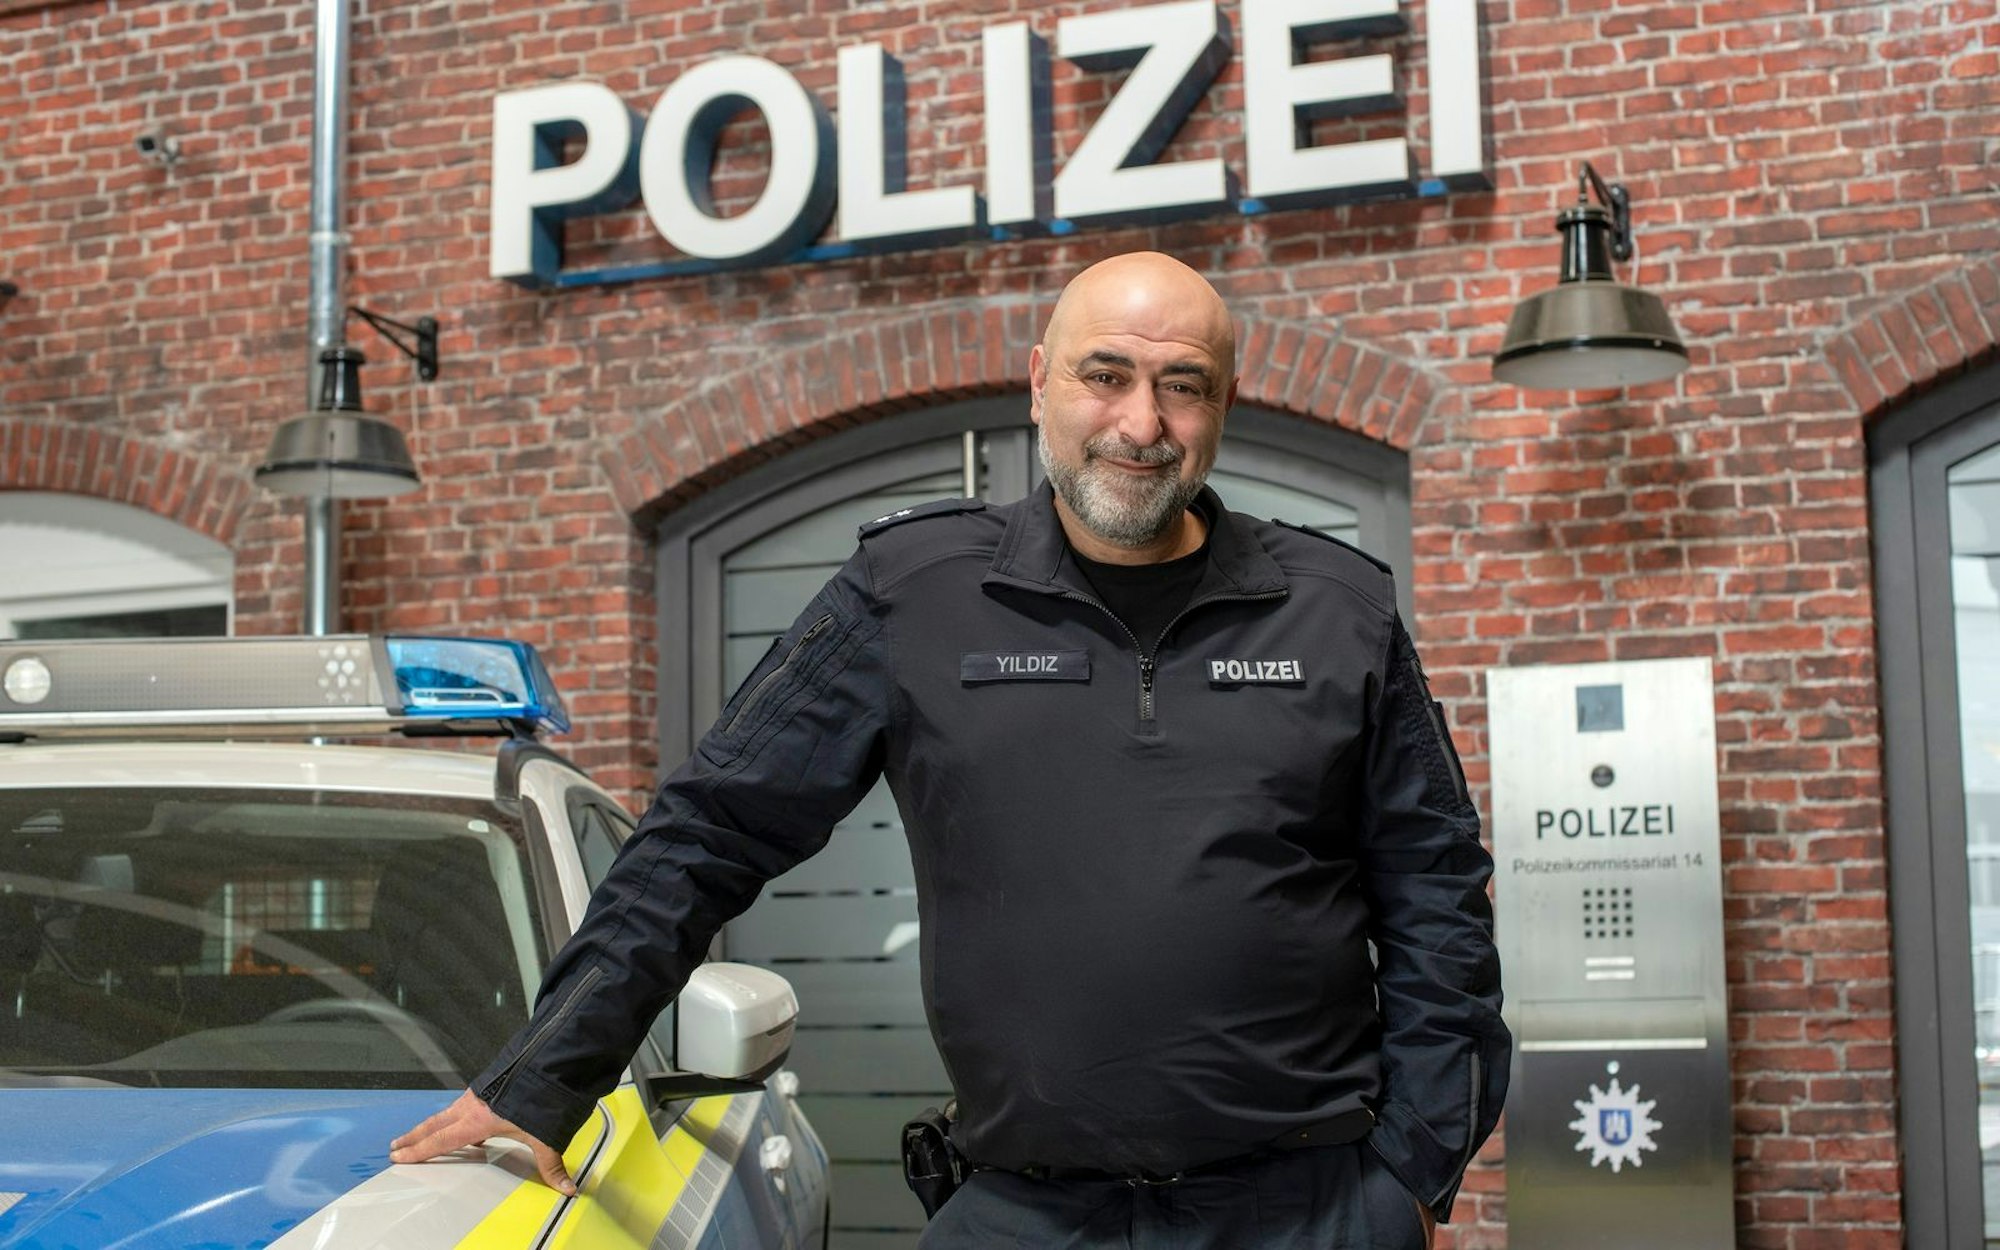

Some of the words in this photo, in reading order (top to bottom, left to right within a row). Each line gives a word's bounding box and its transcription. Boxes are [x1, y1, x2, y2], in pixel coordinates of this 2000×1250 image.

[489, 0, 1484, 278] POLIZEI
[996, 655, 1059, 673] YILDIZ
[1211, 660, 1301, 681] POLIZEI
[1536, 805, 1674, 839] POLIZEI
[1513, 855, 1677, 874] Polizeikommissariat
[1683, 853, 1703, 867] 14
